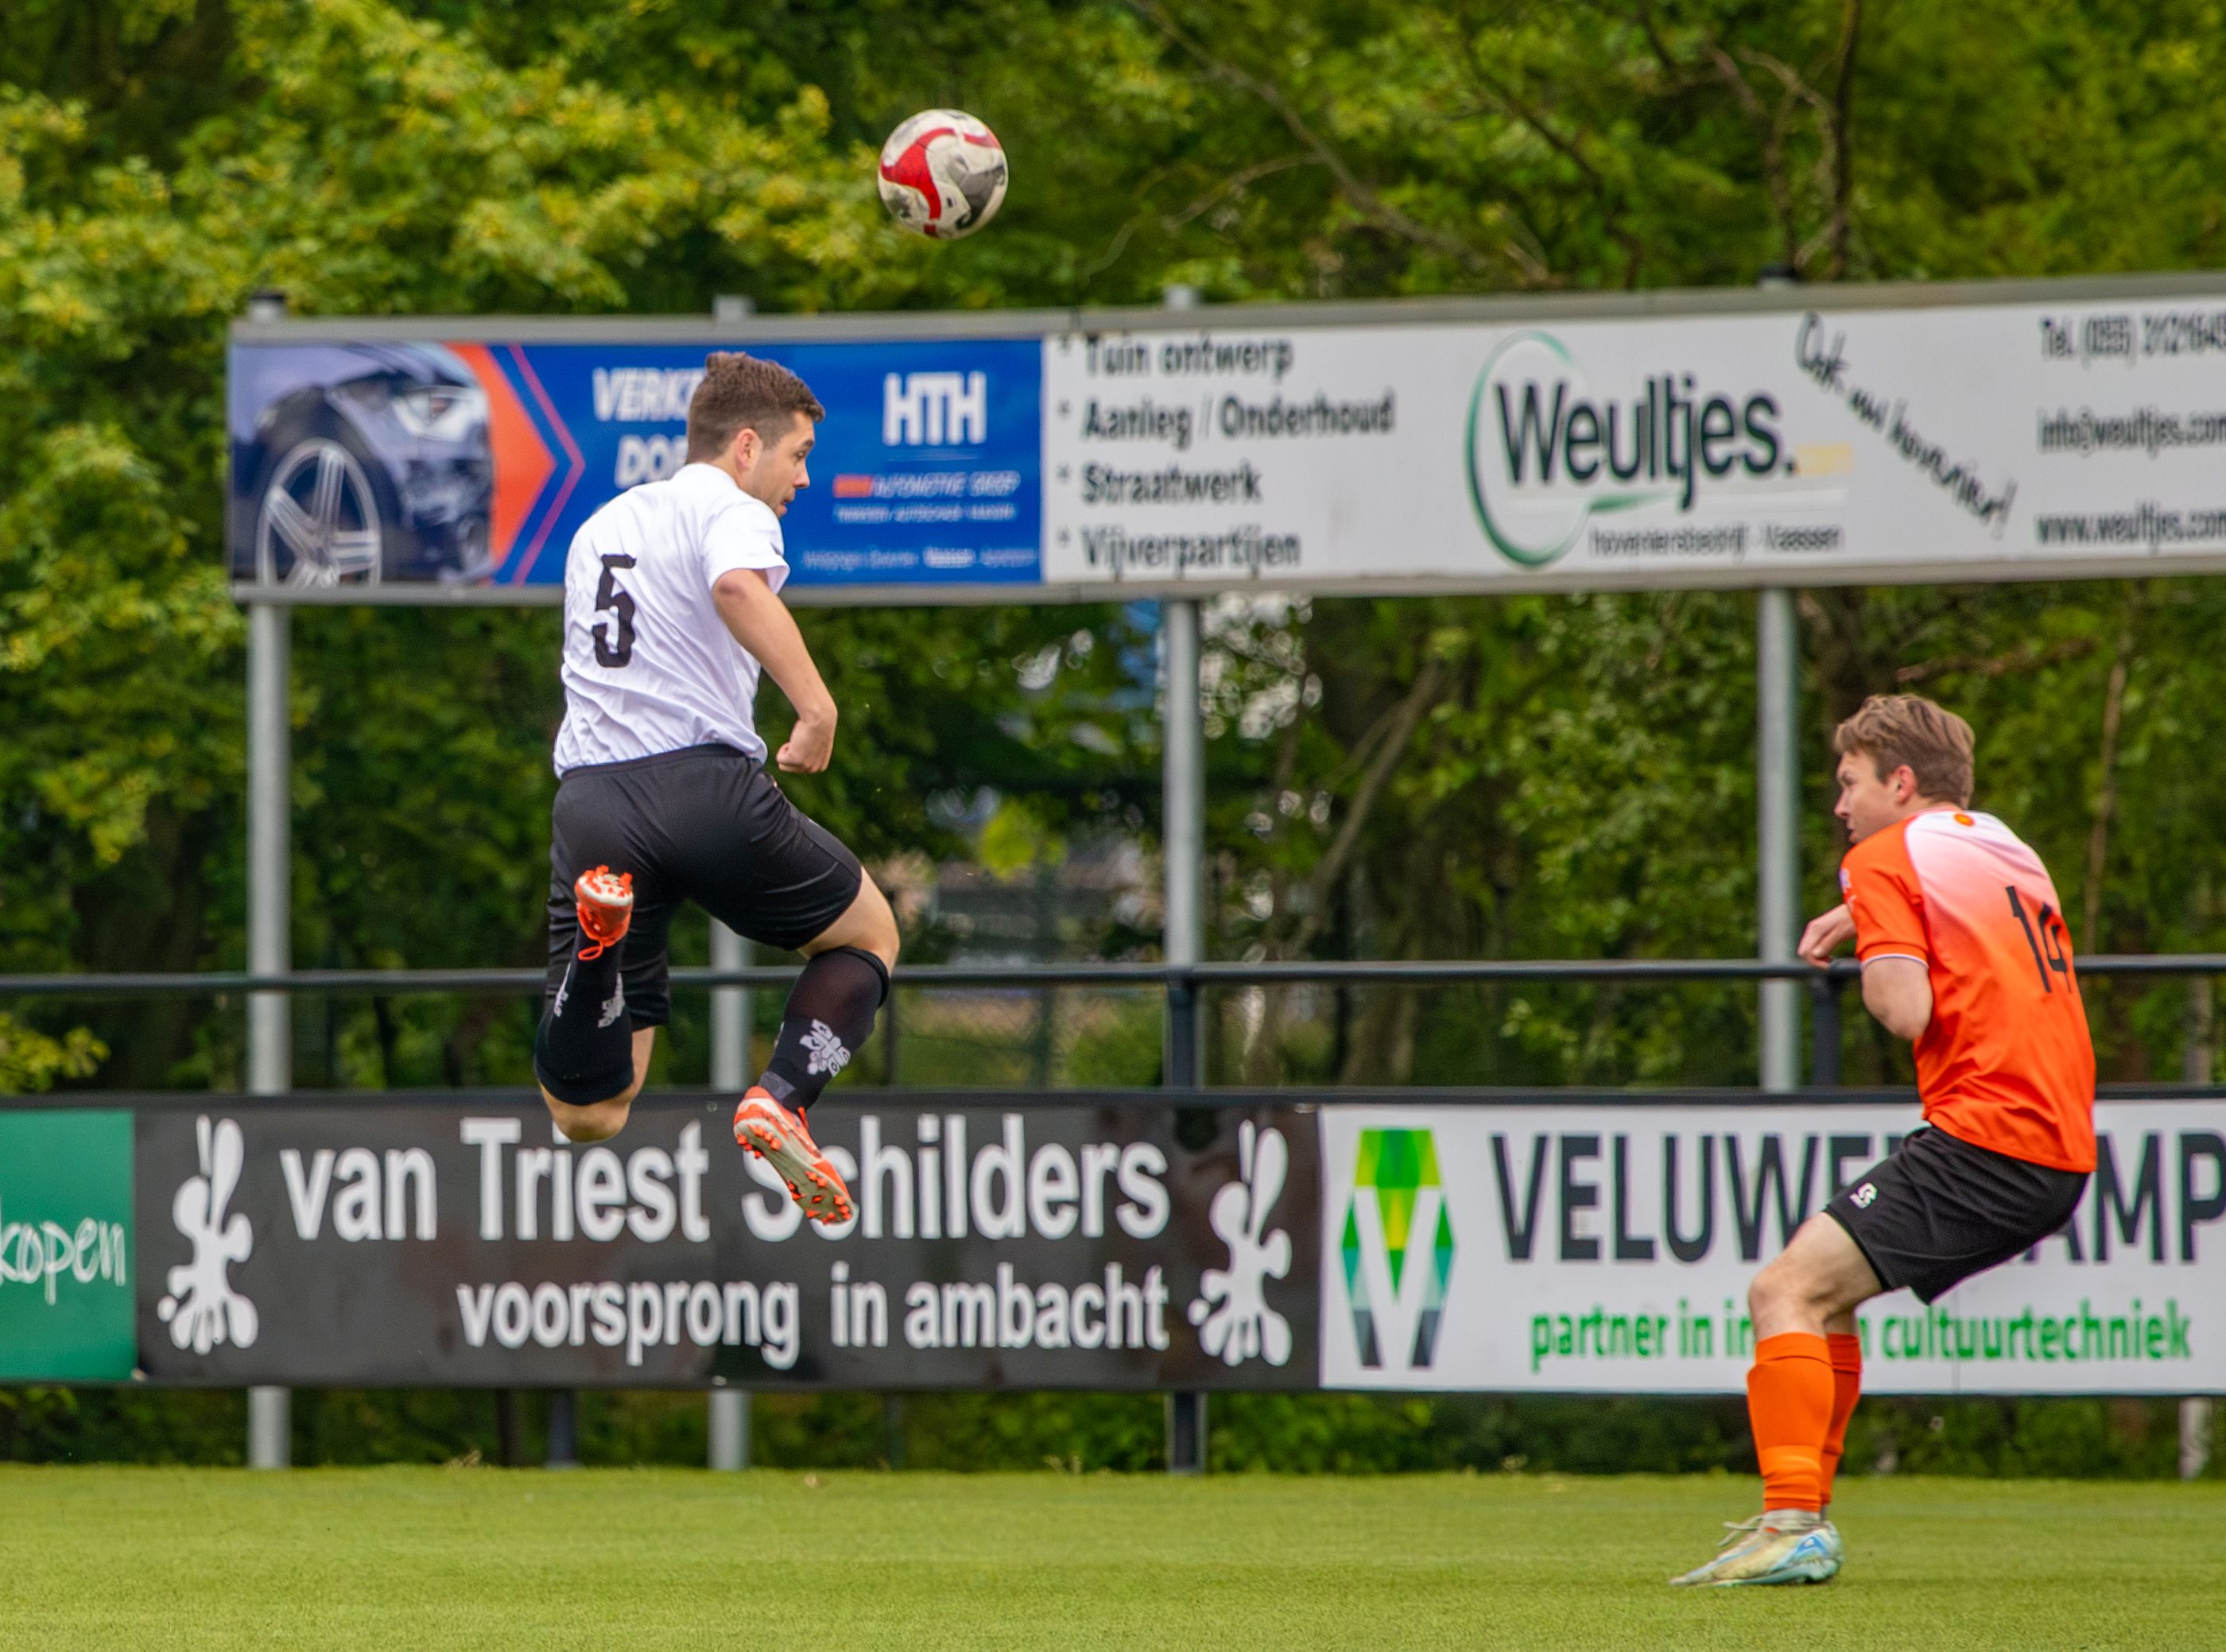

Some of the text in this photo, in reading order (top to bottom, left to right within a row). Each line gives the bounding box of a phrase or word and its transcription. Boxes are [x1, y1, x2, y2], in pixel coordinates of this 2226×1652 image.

[1084, 334, 1294, 383] Tuin ontwerp
[882, 371, 987, 445] HTH
[1080, 397, 1192, 451] Aanleg
[1216, 386, 1396, 439] Onderhoud
[1079, 459, 1264, 506] Straatwerk
[1079, 523, 1302, 583] Vijverpartijen
[591, 553, 637, 669] 5
[280, 1114, 1171, 1243] van Triest Schilders
[456, 1262, 1170, 1371] voorsprong in ambacht
[1531, 1304, 1671, 1374] partner
[1679, 1299, 1713, 1358] in
[1881, 1299, 2193, 1360] cultuurtechniek
